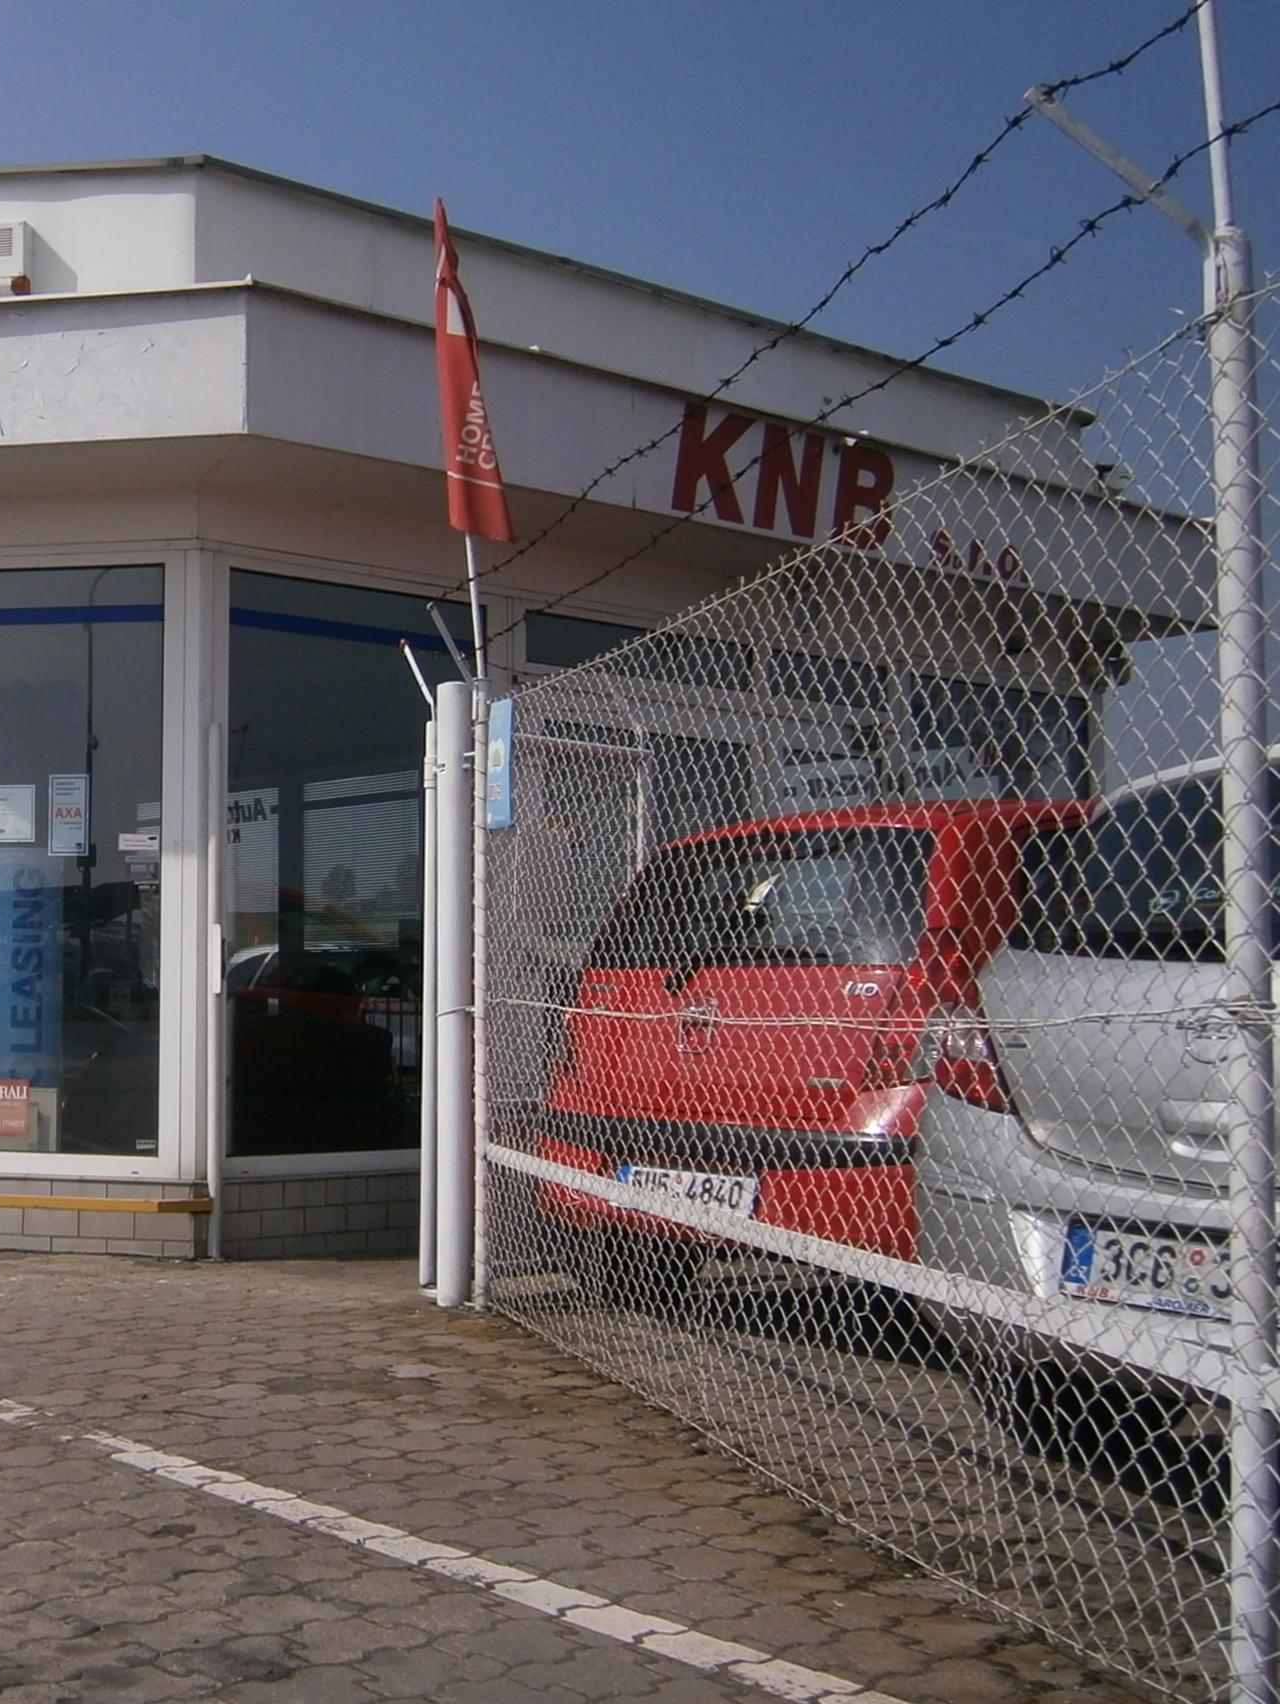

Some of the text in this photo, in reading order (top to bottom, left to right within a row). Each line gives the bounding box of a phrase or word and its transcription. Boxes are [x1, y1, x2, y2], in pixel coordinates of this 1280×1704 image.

[671, 402, 894, 550] KNB
[55, 807, 83, 819] AXA
[11, 866, 44, 1053] LEASING
[1100, 1238, 1176, 1290] 3C6
